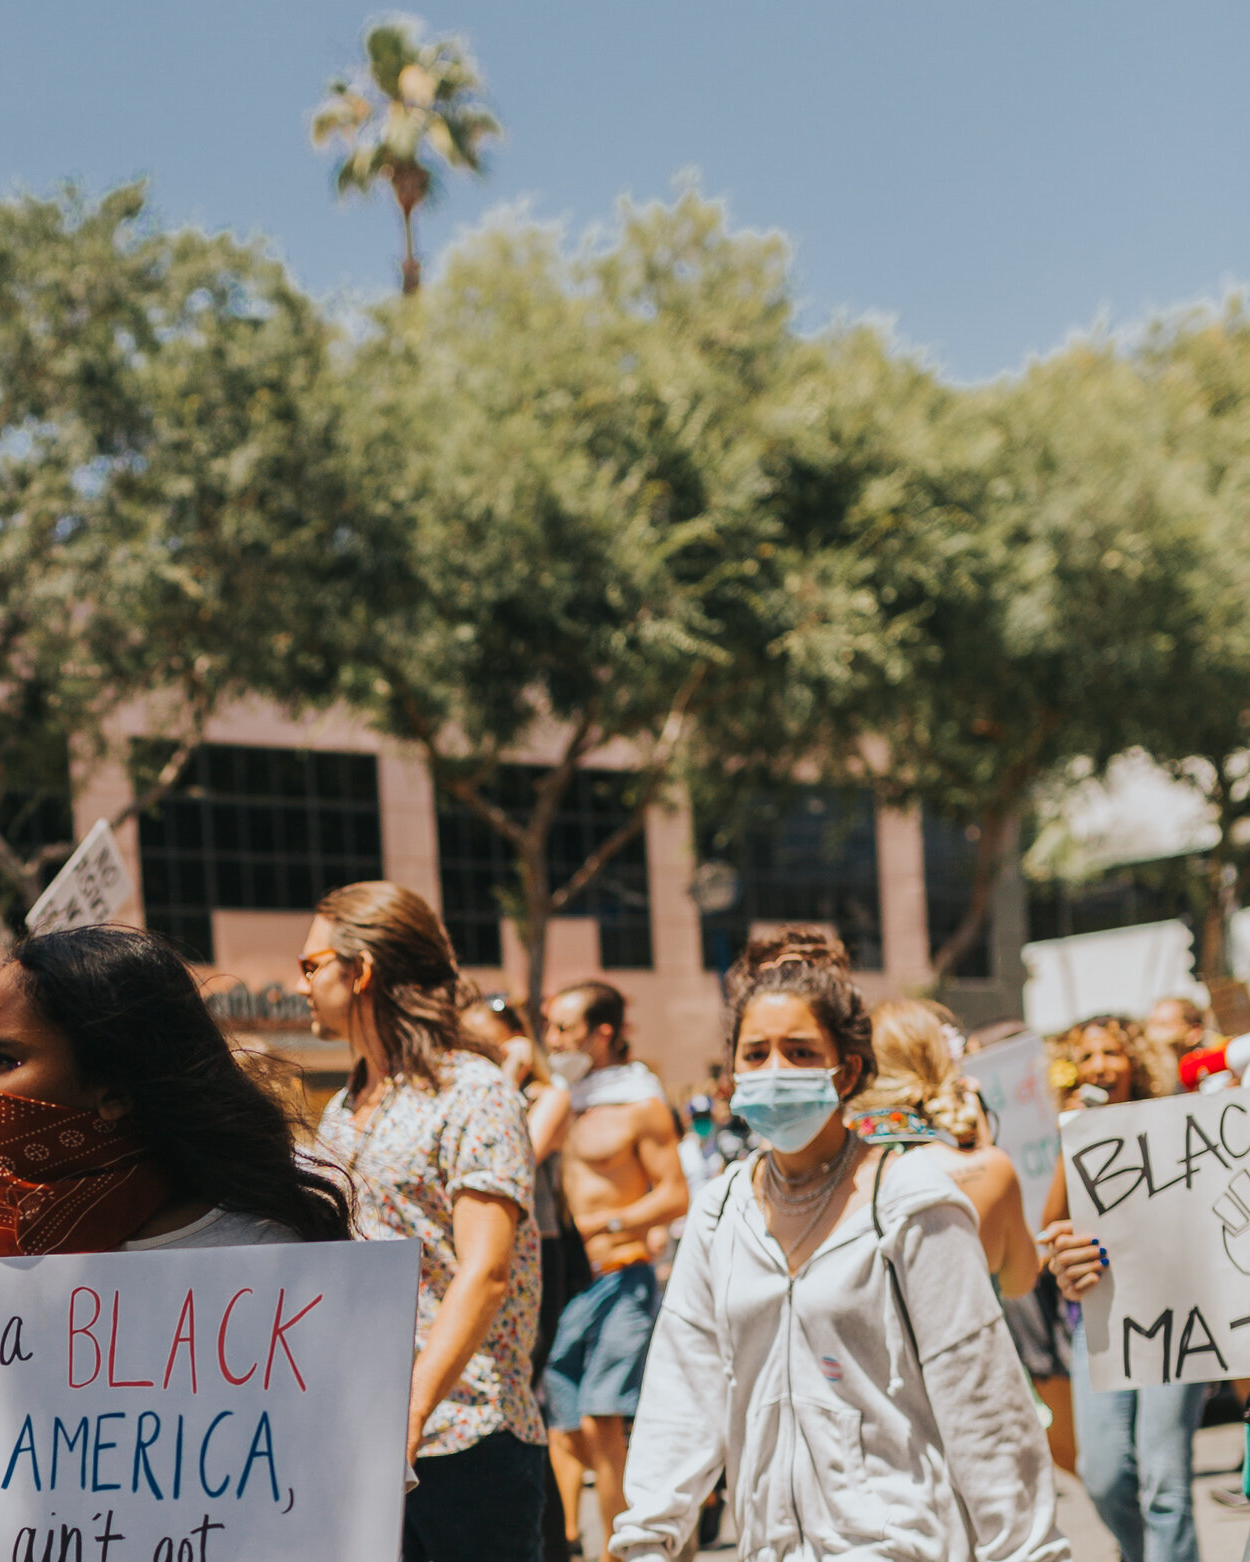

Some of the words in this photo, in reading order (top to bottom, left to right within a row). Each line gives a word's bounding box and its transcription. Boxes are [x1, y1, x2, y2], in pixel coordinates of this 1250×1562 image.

[0, 1315, 34, 1366] a
[68, 1286, 323, 1394] BLACK
[1, 1410, 295, 1514] AMERICA,
